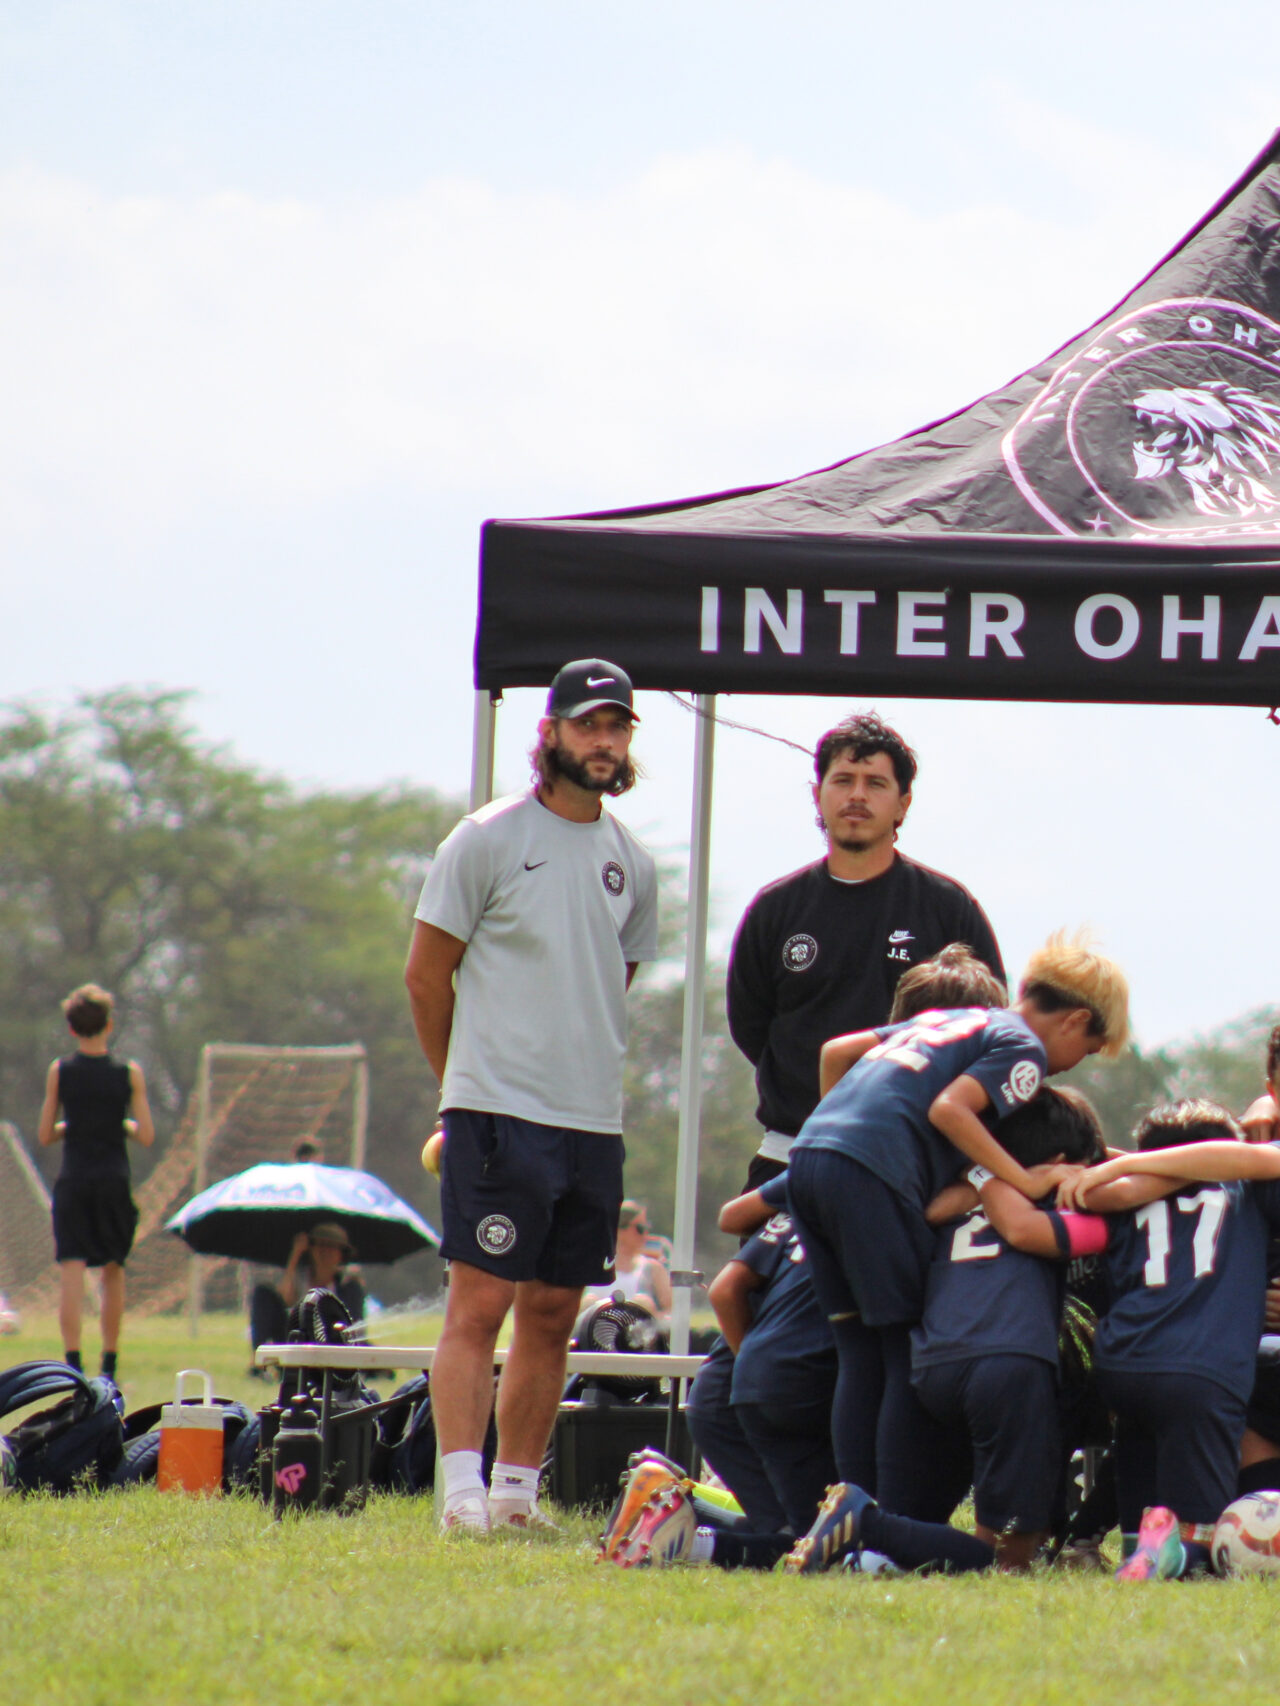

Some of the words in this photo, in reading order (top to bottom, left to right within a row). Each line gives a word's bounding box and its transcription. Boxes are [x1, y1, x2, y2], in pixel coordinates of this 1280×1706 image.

[1031, 327, 1147, 422] INTER
[700, 586, 1026, 657] INTER
[887, 947, 912, 961] J.E.
[1135, 1188, 1226, 1286] 17
